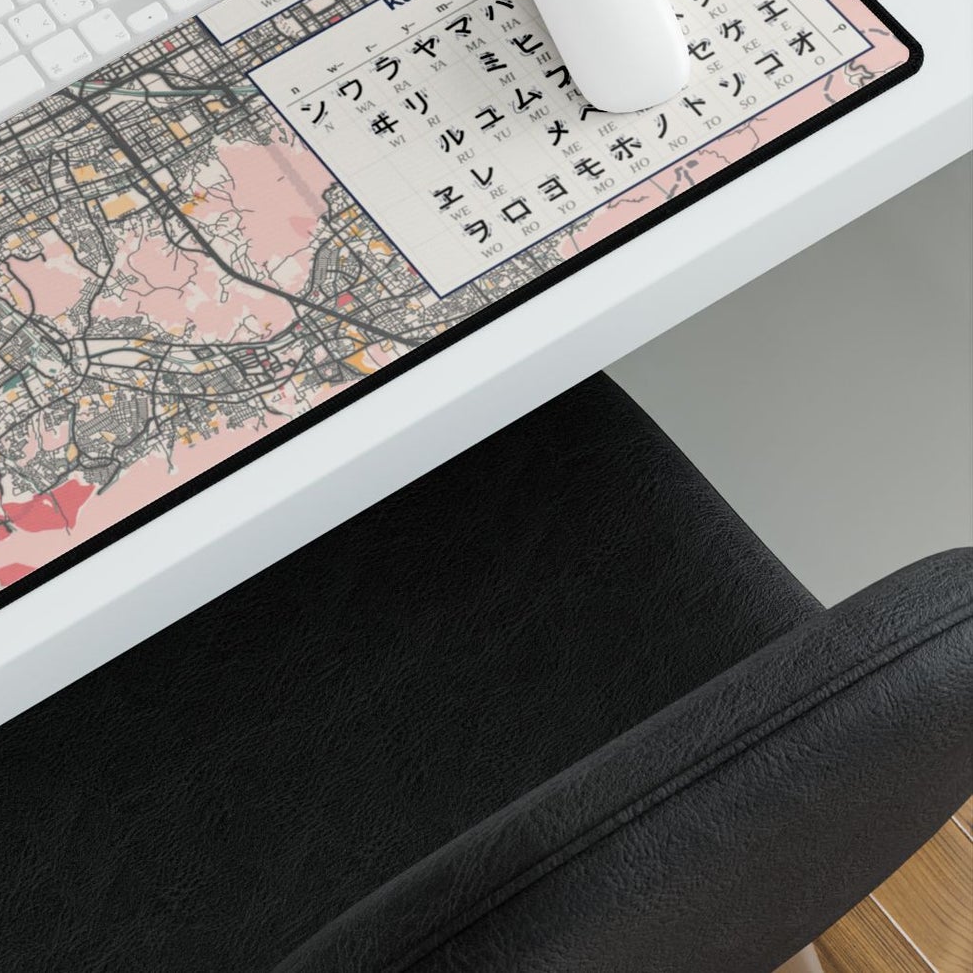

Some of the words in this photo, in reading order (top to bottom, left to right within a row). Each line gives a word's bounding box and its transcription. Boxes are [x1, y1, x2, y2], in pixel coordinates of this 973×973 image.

[301, 101, 325, 124] ン
[338, 79, 363, 101] ワ
[375, 56, 399, 81] ラ
[412, 37, 437, 58] ヤ
[444, 16, 473, 35] マ
[485, 0, 515, 21] ハ
[324, 122, 334, 133] N
[356, 99, 377, 115] WA
[393, 80, 412, 94] RA
[429, 59, 447, 73] YA
[465, 37, 487, 53] MA
[501, 17, 521, 32] HA
[371, 114, 399, 135] ヰ
[405, 91, 428, 115] リ
[479, 51, 508, 73] ミ
[510, 33, 544, 55] ヒ
[433, 186, 464, 210] ヱ
[470, 167, 493, 186] レ
[547, 120, 569, 146] メ
[687, 41, 715, 61] セ
[722, 20, 742, 42] ケ
[758, 0, 788, 23] エ
[440, 129, 465, 153] ル
[474, 108, 505, 130] ユ
[514, 88, 543, 111] ム
[545, 64, 572, 89] フ
[464, 219, 489, 244] ヲ
[501, 199, 532, 224] ロ
[537, 177, 568, 202] ヨ
[574, 158, 605, 177] モ
[610, 137, 642, 161] ホ
[658, 113, 667, 139] ノ
[683, 97, 706, 116] ト
[719, 73, 741, 97] ソ
[755, 53, 784, 75] コ
[789, 32, 815, 56] オ
[480, 242, 504, 259] WO
[521, 220, 541, 236] RO
[557, 199, 577, 216] YO
[593, 177, 616, 195] MO
[629, 157, 651, 174] HO
[668, 135, 688, 152] NO
[703, 115, 722, 130] TO
[739, 95, 758, 110] SO
[774, 74, 794, 90] KO
